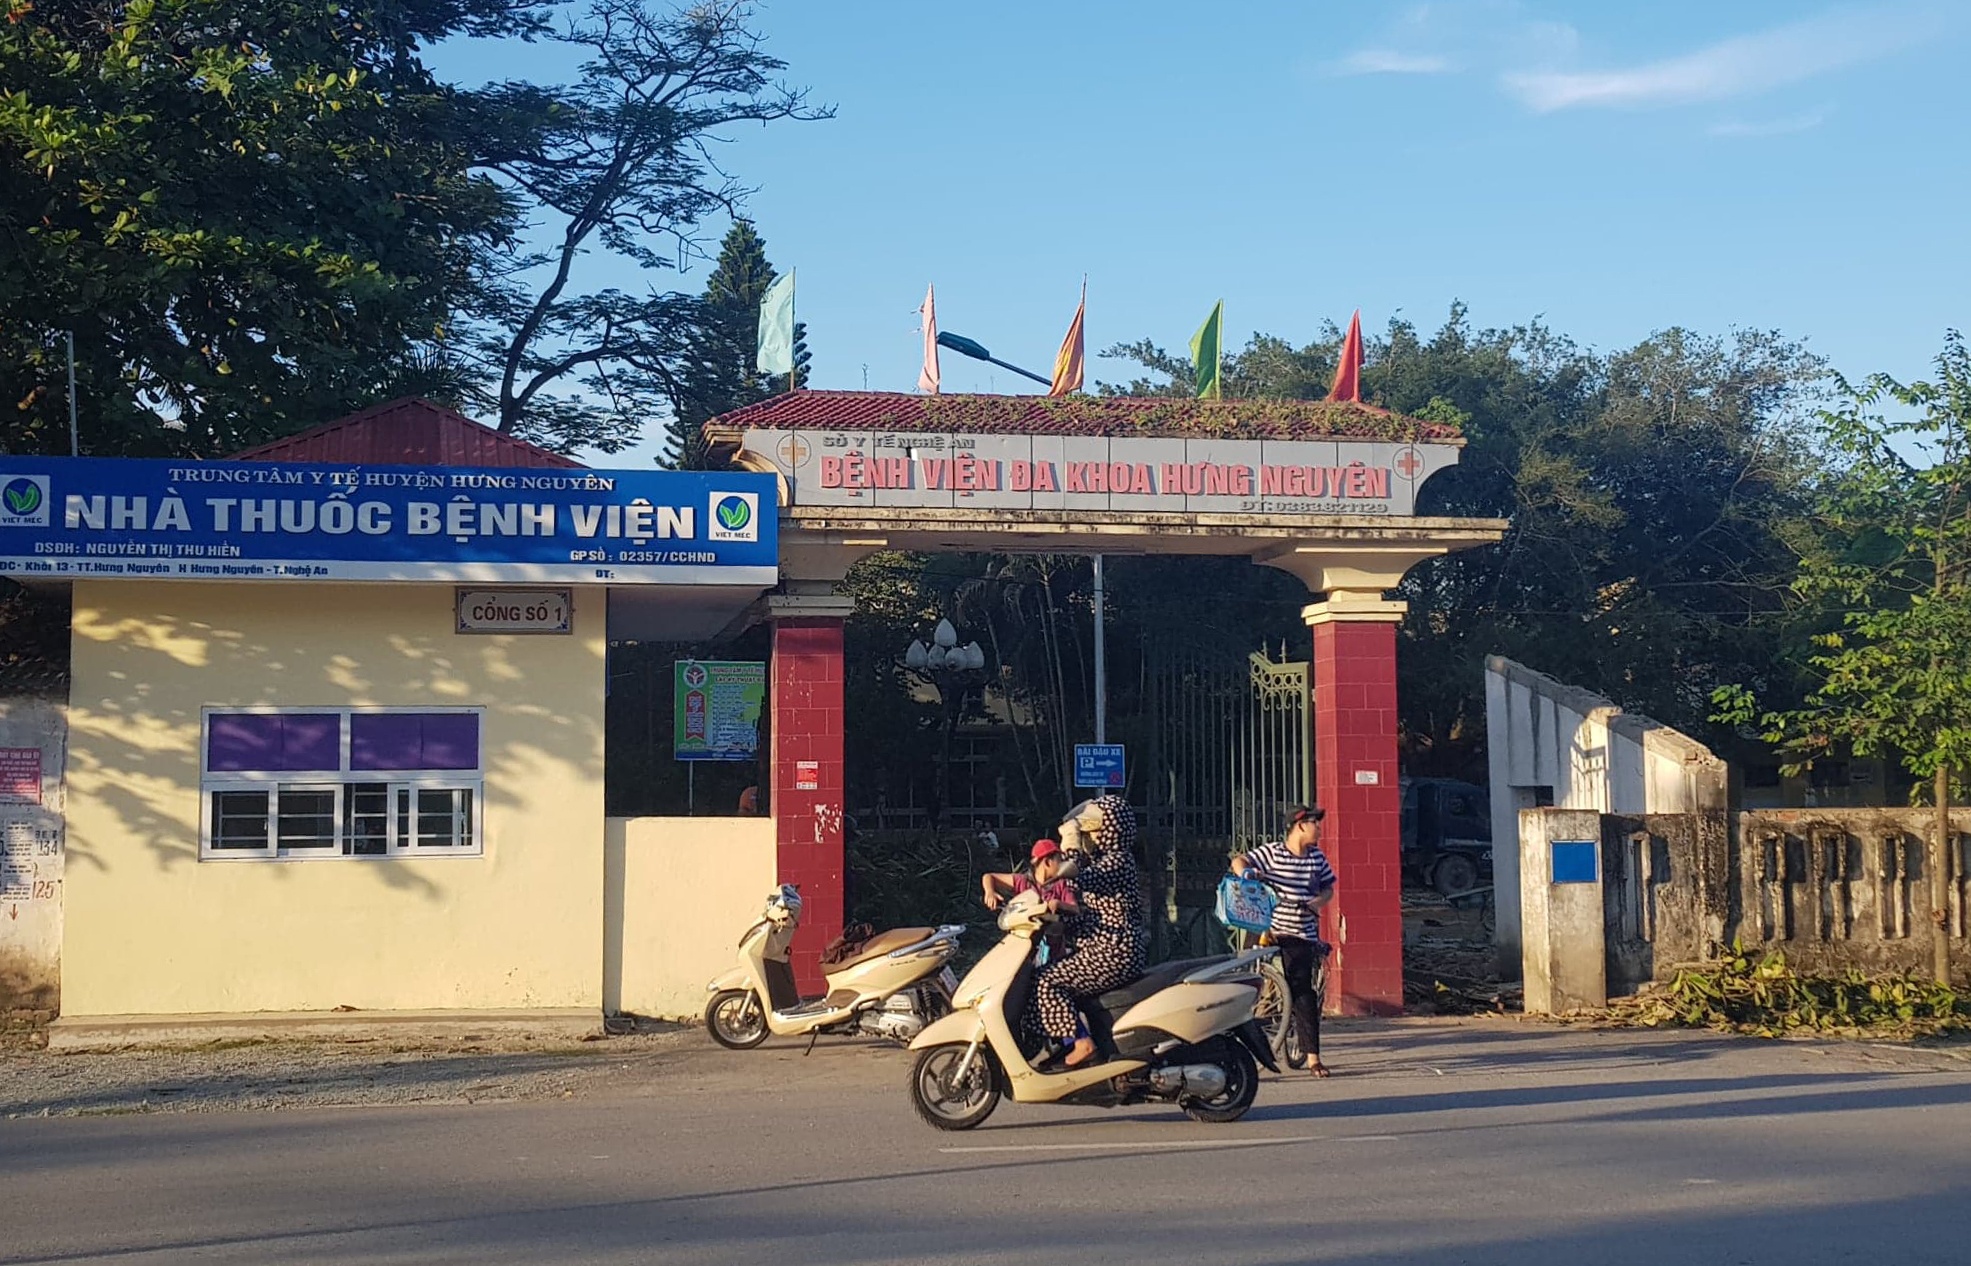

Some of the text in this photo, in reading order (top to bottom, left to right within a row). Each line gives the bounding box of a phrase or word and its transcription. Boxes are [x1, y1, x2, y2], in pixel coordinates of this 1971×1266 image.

[852, 436, 866, 447] Y
[948, 436, 976, 449] AN
[169, 466, 614, 491] TRUNG TÂM Y TẾ HUYỆN HƯNG NGUYÊN
[821, 451, 1387, 498] BỆNH VIỆN ĐA KHOA HƯNG NGUYÊN
[65, 484, 694, 545] NHÀ THUỐC BỆNH VIỆN
[150, 543, 173, 557] THỊ
[177, 544, 203, 555] THU
[619, 551, 716, 563] 02357/CCHND
[127, 563, 170, 574] Nguyên
[190, 564, 220, 575] Hưng
[222, 564, 264, 575] Nguyên
[313, 566, 328, 575] An
[473, 596, 562, 621] CỔNG SỐ 1
